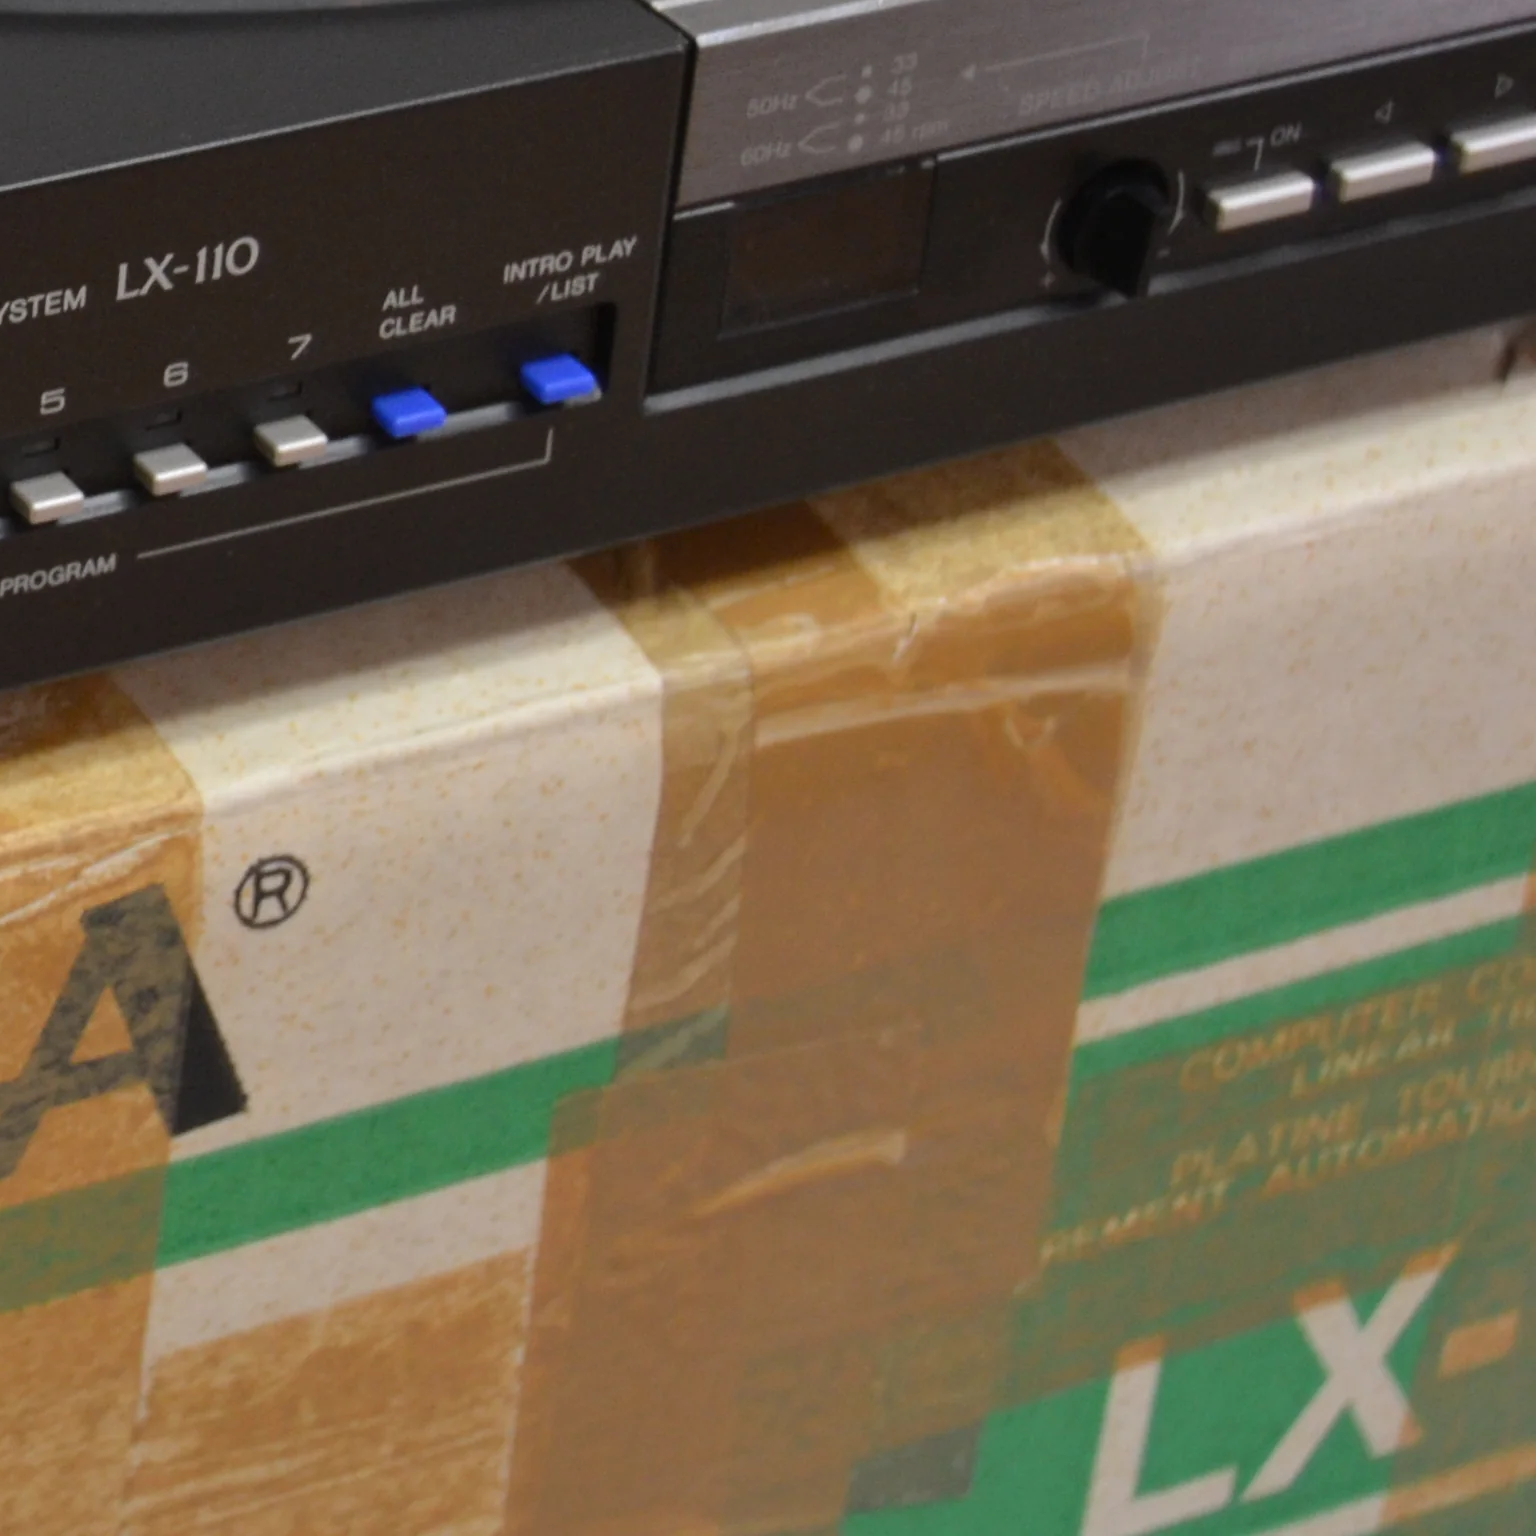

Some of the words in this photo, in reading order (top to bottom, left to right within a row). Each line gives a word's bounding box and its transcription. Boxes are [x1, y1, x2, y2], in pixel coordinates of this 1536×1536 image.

[1269, 122, 1301, 147] ON
[116, 236, 260, 301] LX-110
[503, 251, 573, 283] INTRO
[580, 236, 637, 266] PLAY
[382, 285, 424, 311] ALL
[537, 272, 599, 304] /LIST
[379, 304, 456, 339] CLEAR
[287, 333, 312, 359] 7
[163, 361, 188, 387] 6
[39, 387, 66, 414] 5
[0, 552, 117, 598] PROGRAM
